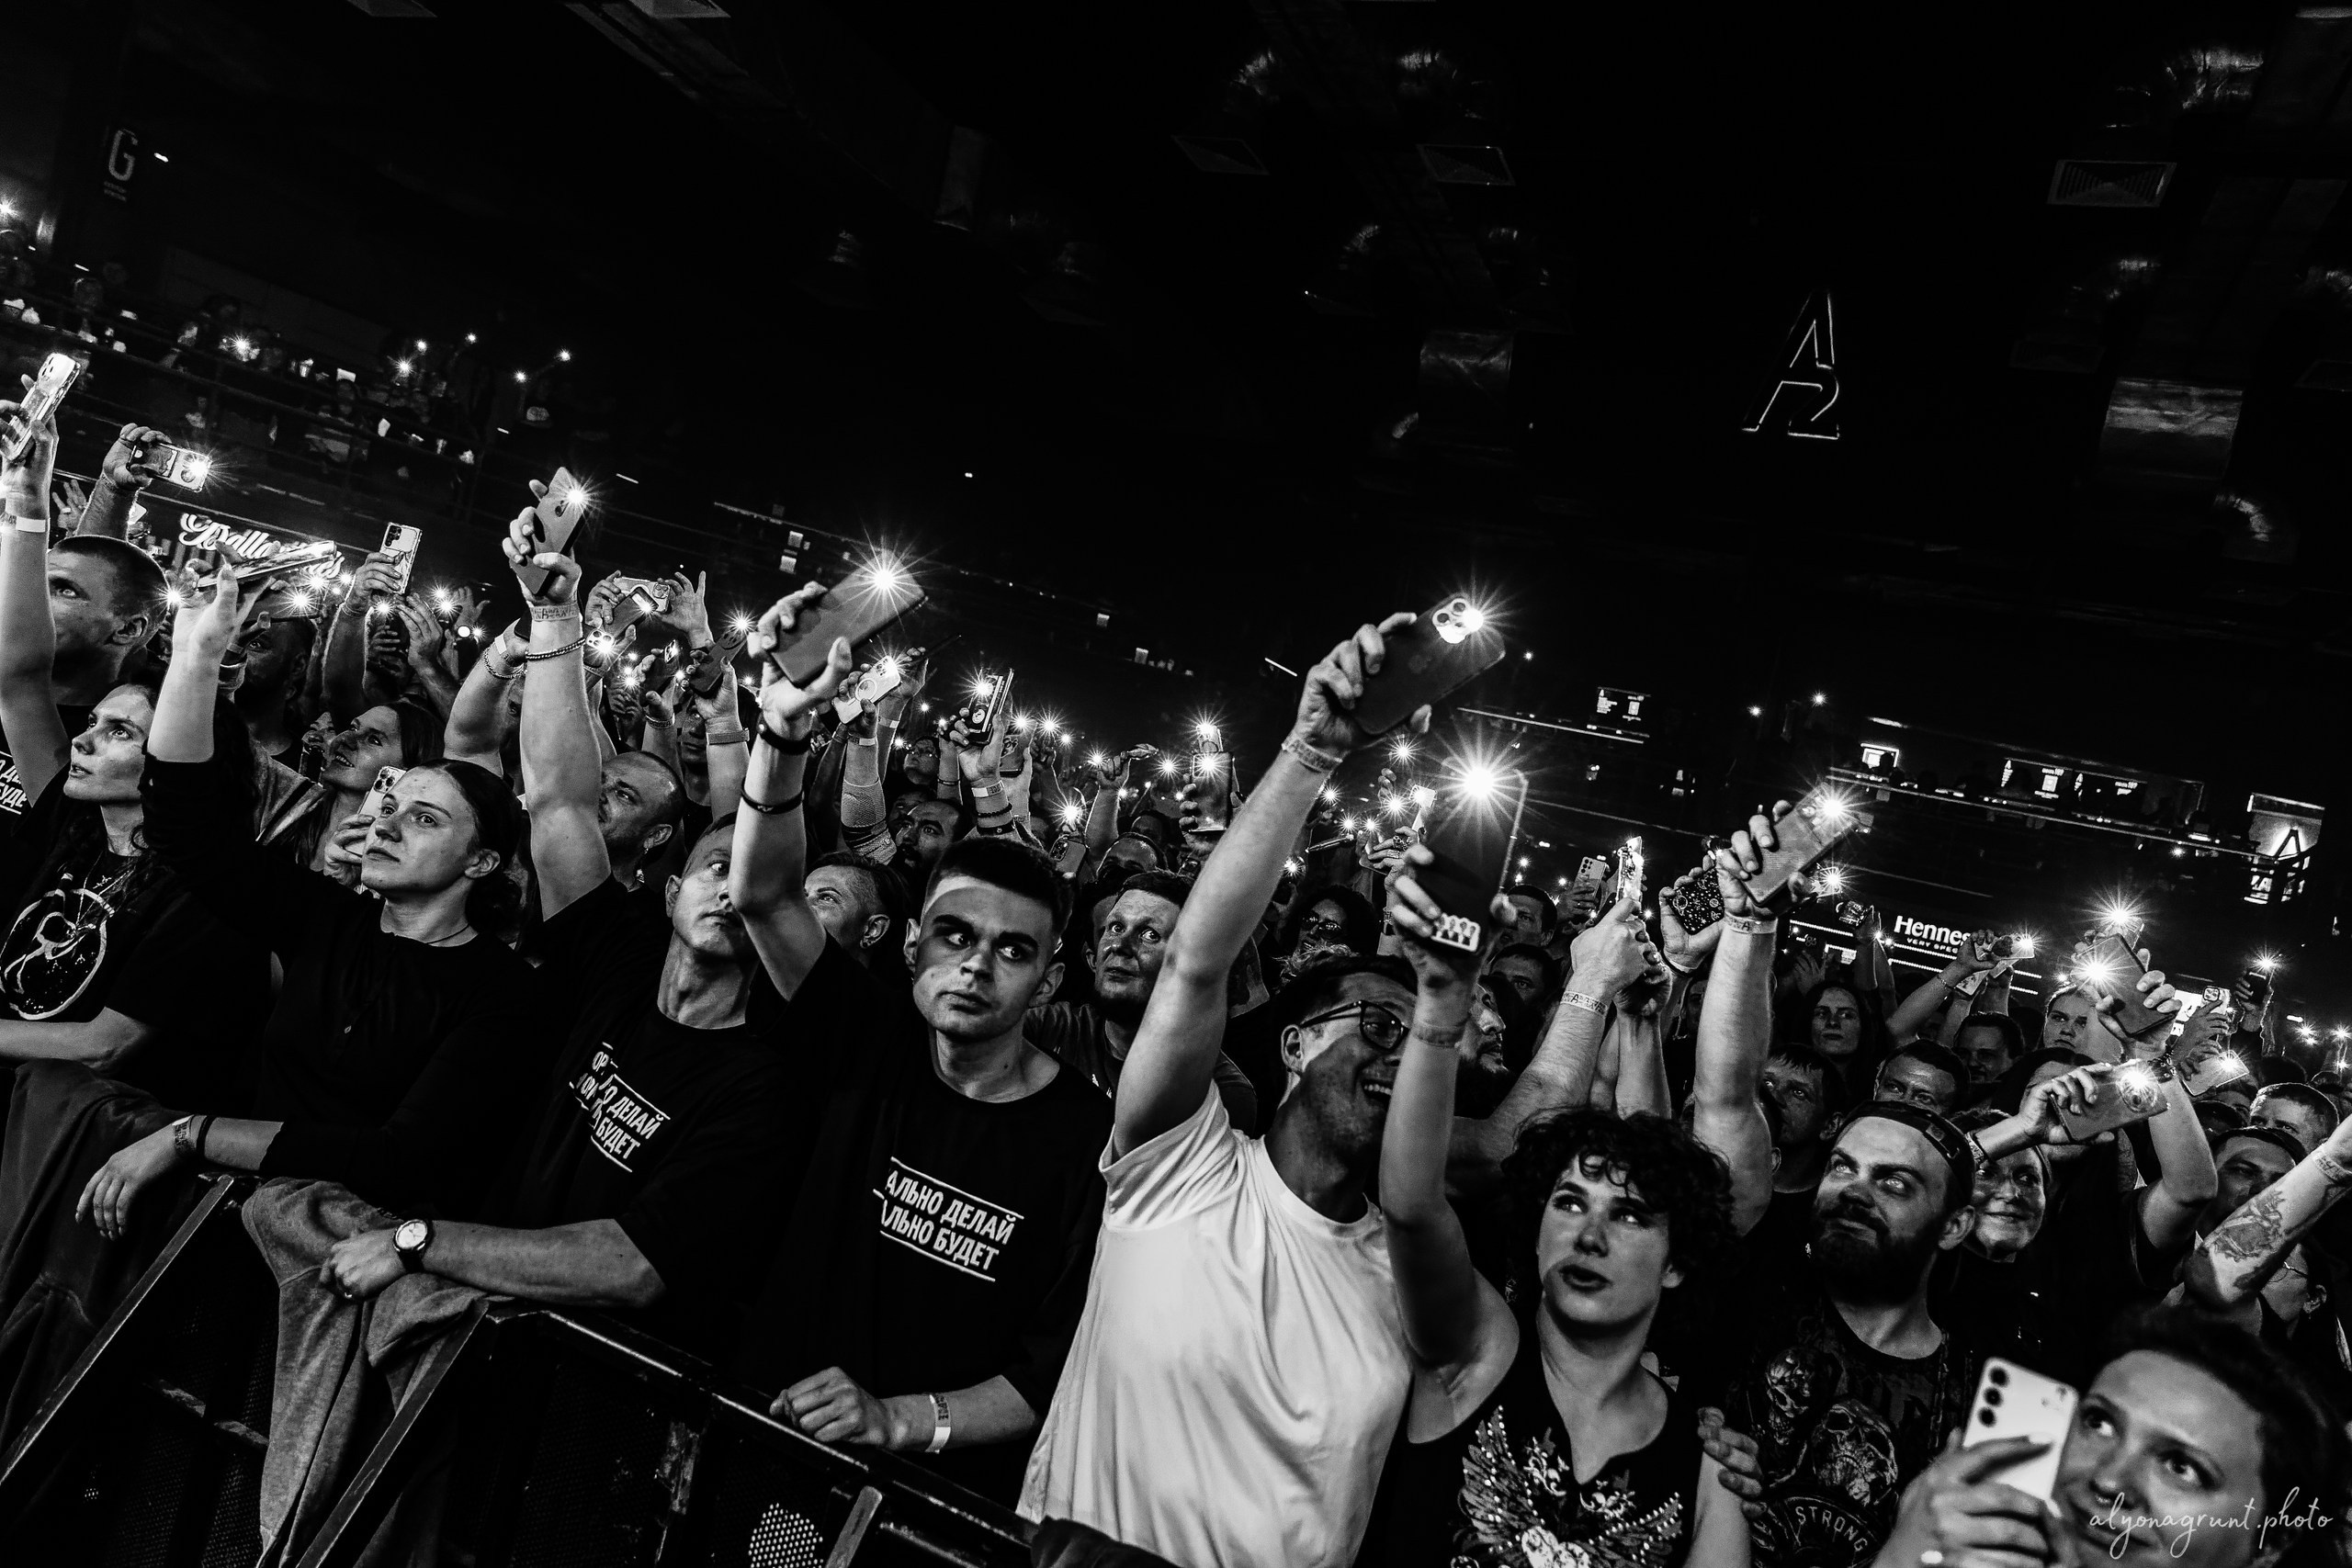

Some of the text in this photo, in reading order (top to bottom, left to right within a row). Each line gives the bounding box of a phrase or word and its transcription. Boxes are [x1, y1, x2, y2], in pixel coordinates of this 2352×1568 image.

[0, 782, 28, 808] УДЕ
[1894, 915, 1971, 946] Hennes
[1933, 943, 1959, 954] SPEC
[595, 1116, 641, 1159] БУДЕТ
[606, 1095, 662, 1140] ДЕЛАЙ
[885, 1169, 1016, 1245] АЛЬНО ДЕЛАЙ
[933, 1227, 1000, 1270] БУДЕТ
[1794, 1506, 1869, 1552] STRONG
